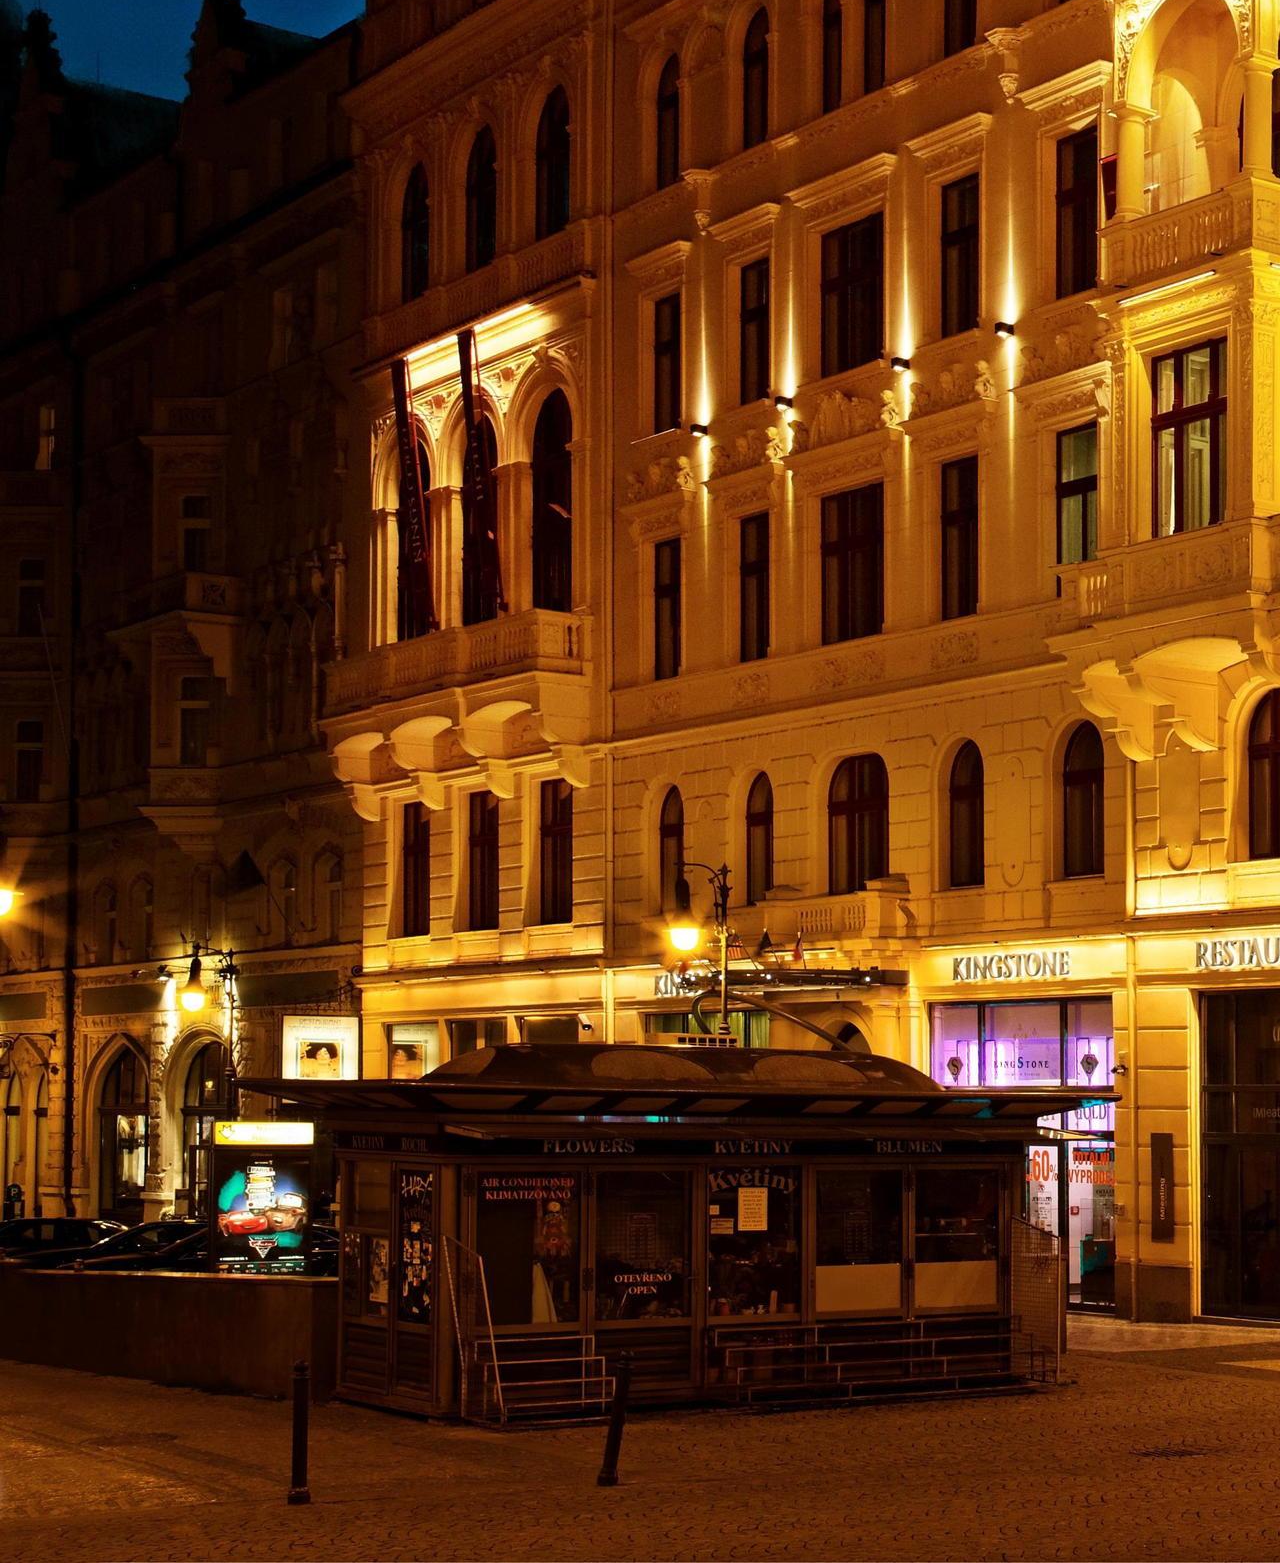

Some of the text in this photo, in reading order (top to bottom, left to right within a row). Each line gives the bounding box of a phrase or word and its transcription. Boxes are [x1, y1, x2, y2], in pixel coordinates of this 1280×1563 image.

[952, 950, 1071, 982] KINGSTONE
[543, 1139, 635, 1154] FLOWERS
[876, 1139, 943, 1154] BLUMEN
[481, 1177, 575, 1188] AIR CONDITIONED
[628, 1285, 658, 1295] OPEN
